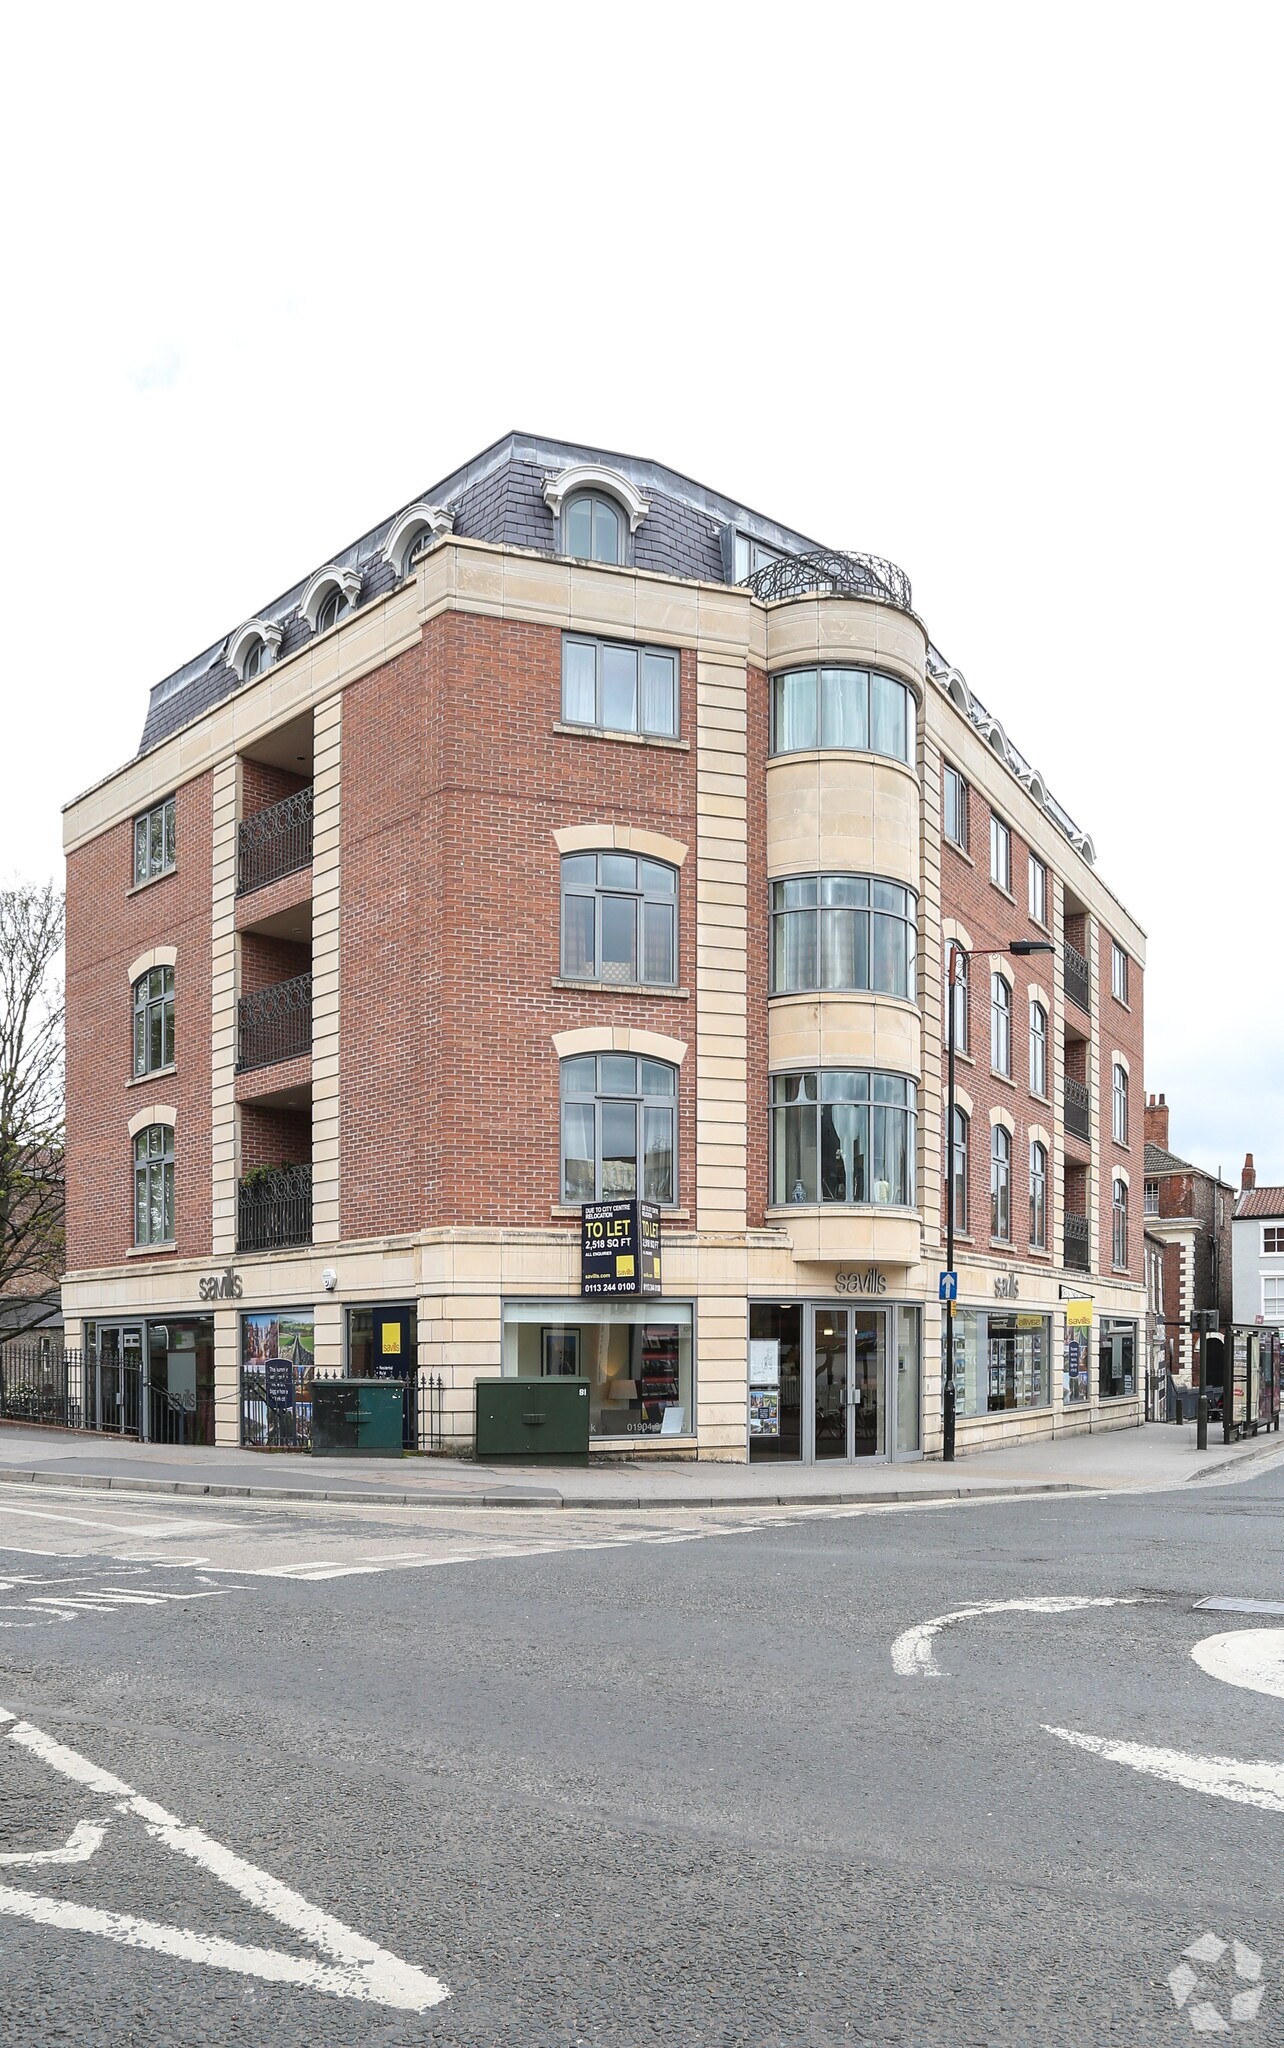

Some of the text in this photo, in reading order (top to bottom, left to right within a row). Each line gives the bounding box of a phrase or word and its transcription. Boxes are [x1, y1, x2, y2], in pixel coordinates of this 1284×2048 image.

[613, 1204, 631, 1212] CENTRE
[585, 1212, 614, 1220] RELOCATION
[585, 1219, 631, 1238] TO LET
[642, 1220, 659, 1239] TO LET
[585, 1238, 632, 1251] 2,518 SQ FT
[617, 1268, 634, 1276] savills
[198, 1268, 244, 1300] savills
[835, 1268, 887, 1295] savills
[585, 1284, 602, 1293] 0113
[603, 1283, 617, 1292] 244
[617, 1282, 636, 1291] 0100
[1068, 1316, 1091, 1325] savills
[383, 1342, 400, 1352] savills
[626, 1422, 652, 1432] 01904
